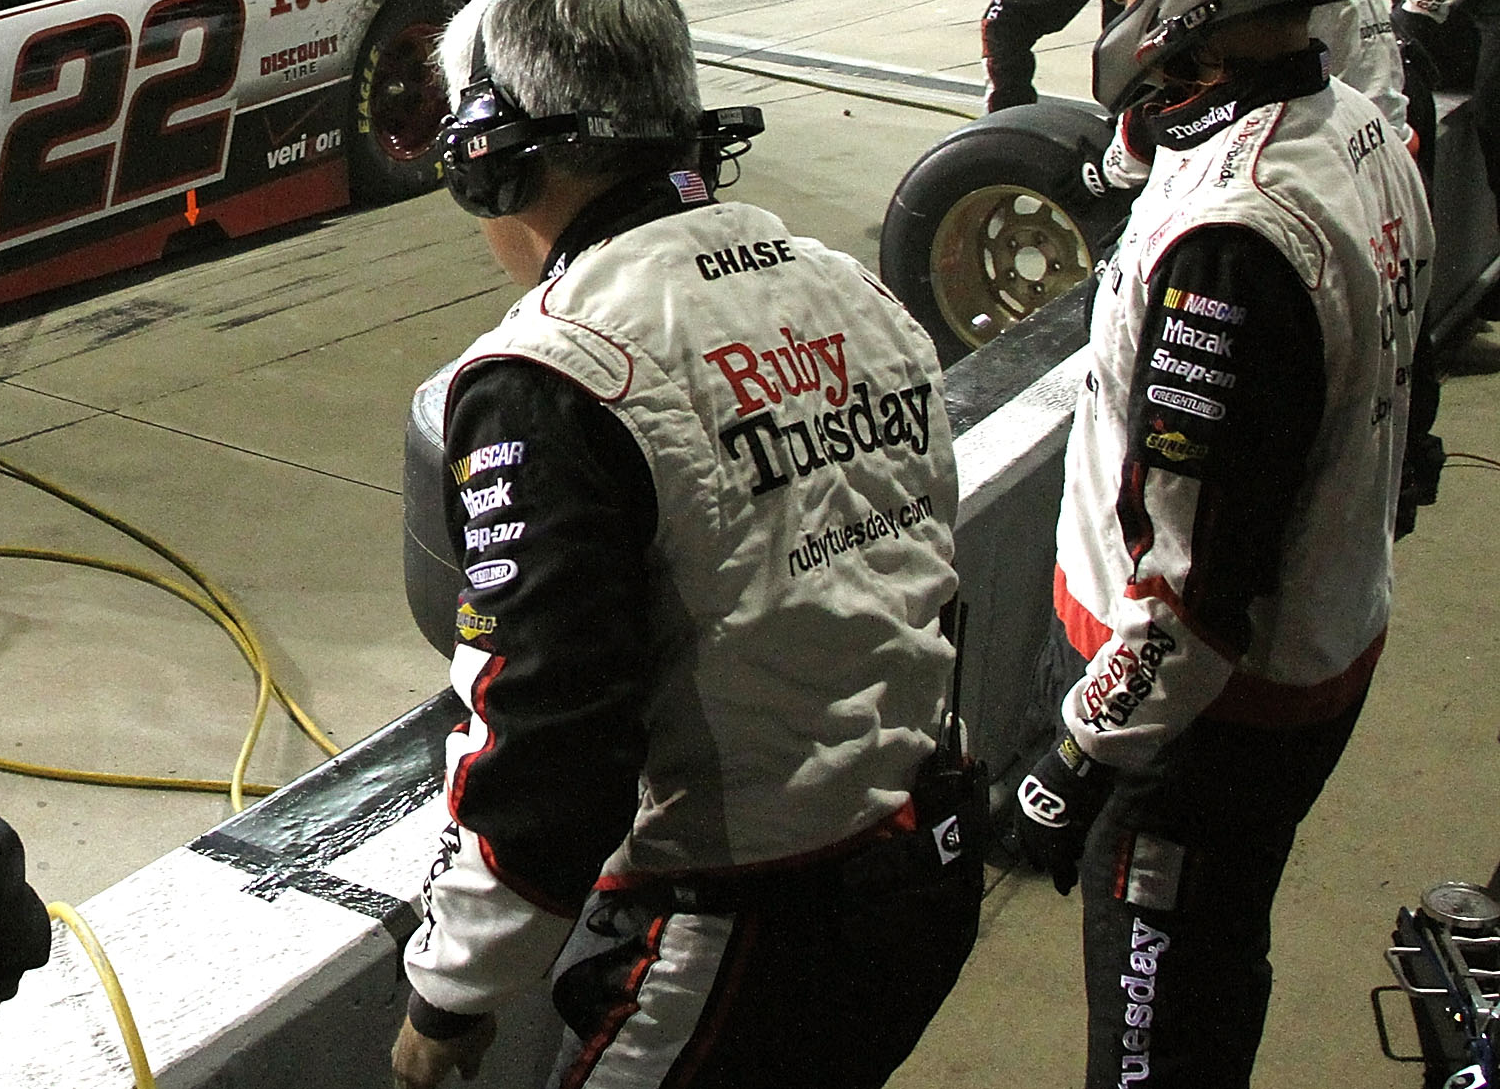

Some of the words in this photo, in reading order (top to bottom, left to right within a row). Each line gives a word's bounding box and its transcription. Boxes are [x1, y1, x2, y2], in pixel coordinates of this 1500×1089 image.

[260, 35, 338, 75] DISCOUNT
[283, 61, 318, 82] TIRE
[358, 44, 380, 133] EAGLE
[1167, 100, 1238, 140] Tuesday
[695, 239, 797, 281] CHASE
[1184, 293, 1247, 325] NASCAR
[1161, 316, 1234, 358] Mazak
[703, 327, 846, 417] Ruby
[1150, 347, 1238, 389] Snap-on
[1152, 388, 1220, 416] FREIGHTLINER
[469, 441, 524, 475] NASCAR
[719, 382, 932, 497] Tuesday
[460, 477, 513, 519] Mazak
[788, 494, 933, 576] rubytuesday.com
[1082, 620, 1176, 733] Tuesday
[1084, 643, 1140, 718] Ruby
[1118, 917, 1171, 1089] uesday
